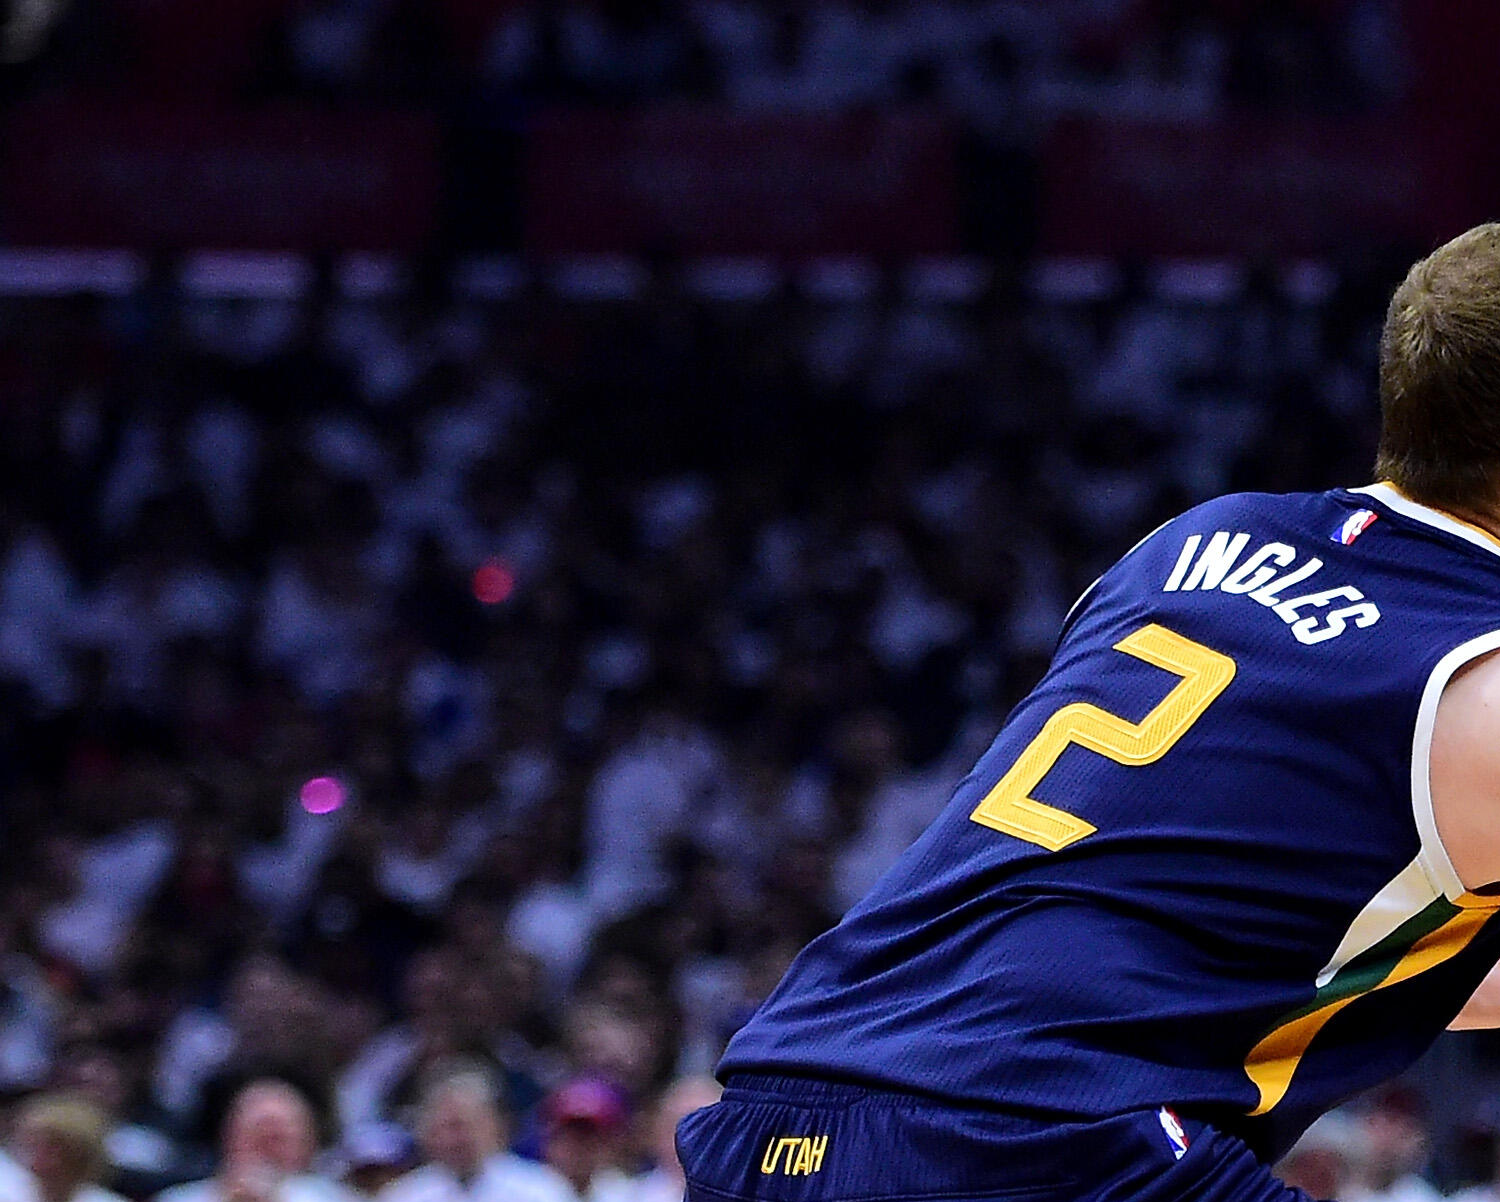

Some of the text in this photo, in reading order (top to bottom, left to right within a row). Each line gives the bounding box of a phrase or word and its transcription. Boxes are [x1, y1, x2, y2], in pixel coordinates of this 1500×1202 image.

[1162, 531, 1381, 645] INGLES
[969, 623, 1237, 852] 2
[761, 1135, 828, 1176] UTAH
